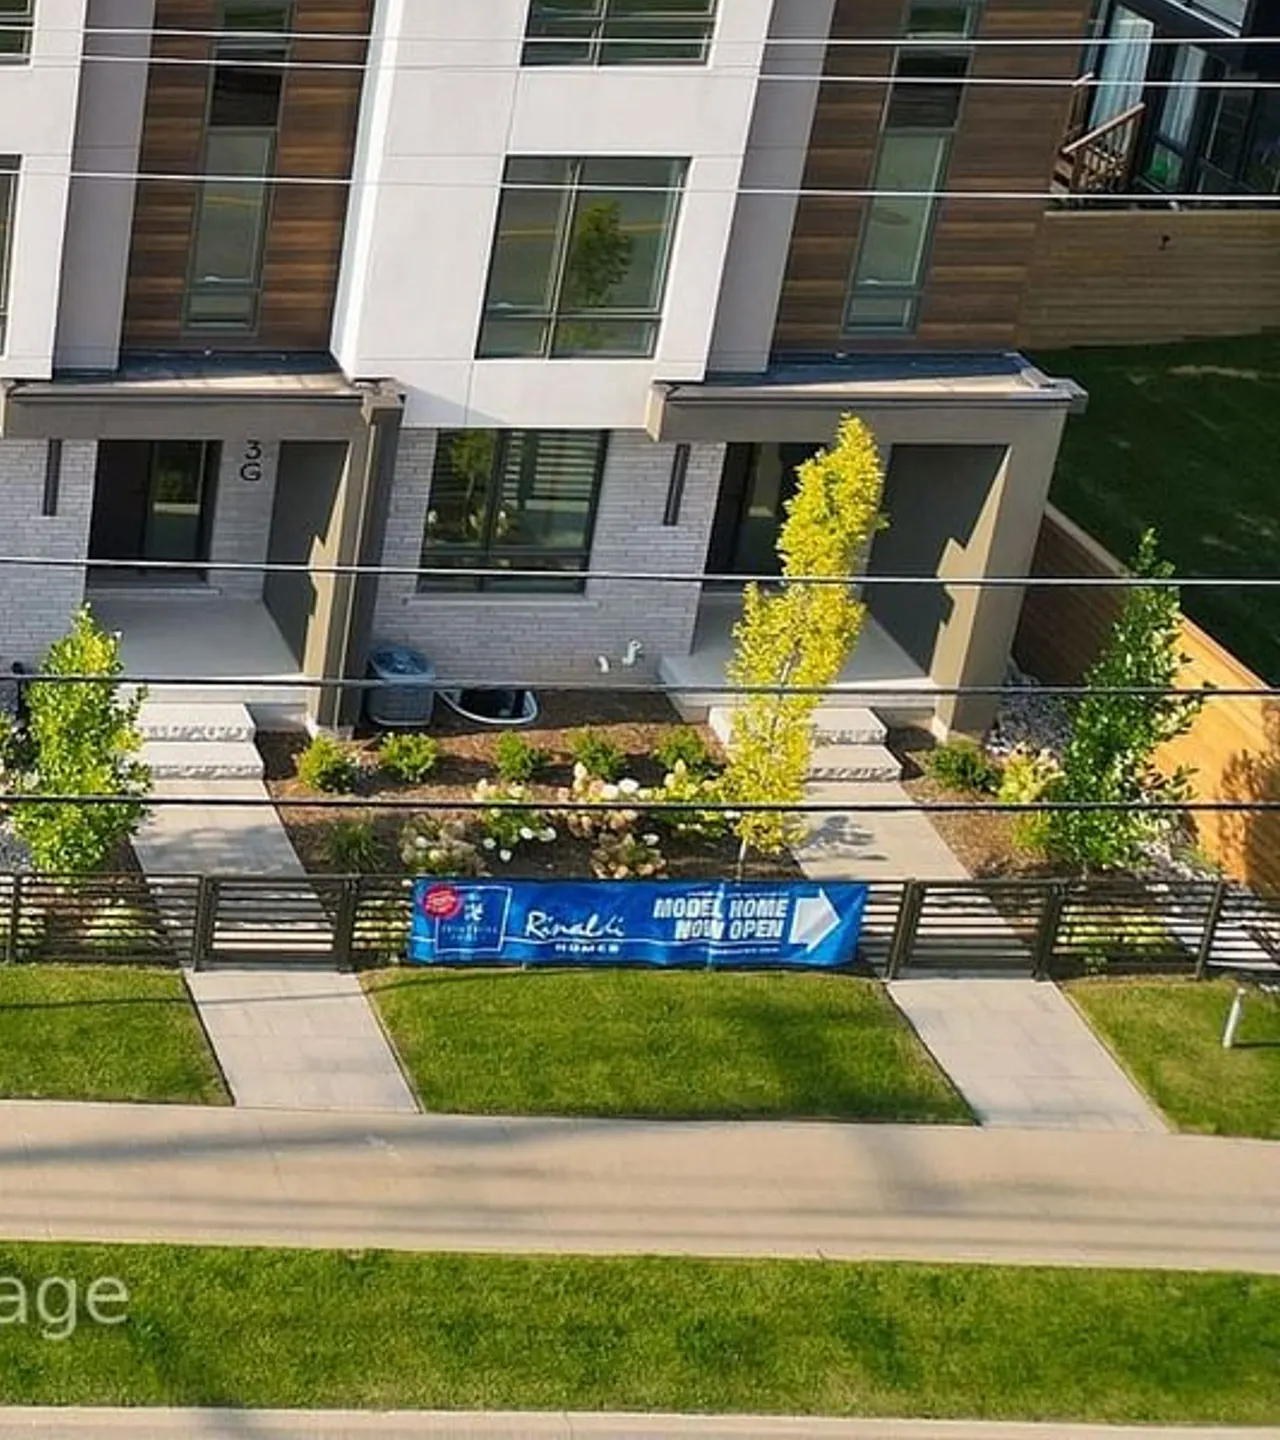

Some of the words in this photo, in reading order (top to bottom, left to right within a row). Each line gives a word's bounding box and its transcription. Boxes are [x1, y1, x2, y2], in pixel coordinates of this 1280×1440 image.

[653, 897, 724, 918] MODEL
[729, 897, 788, 918] HOME
[523, 909, 625, 939] Rinaldi
[675, 919, 725, 940] NOW
[730, 919, 783, 939] OPEN
